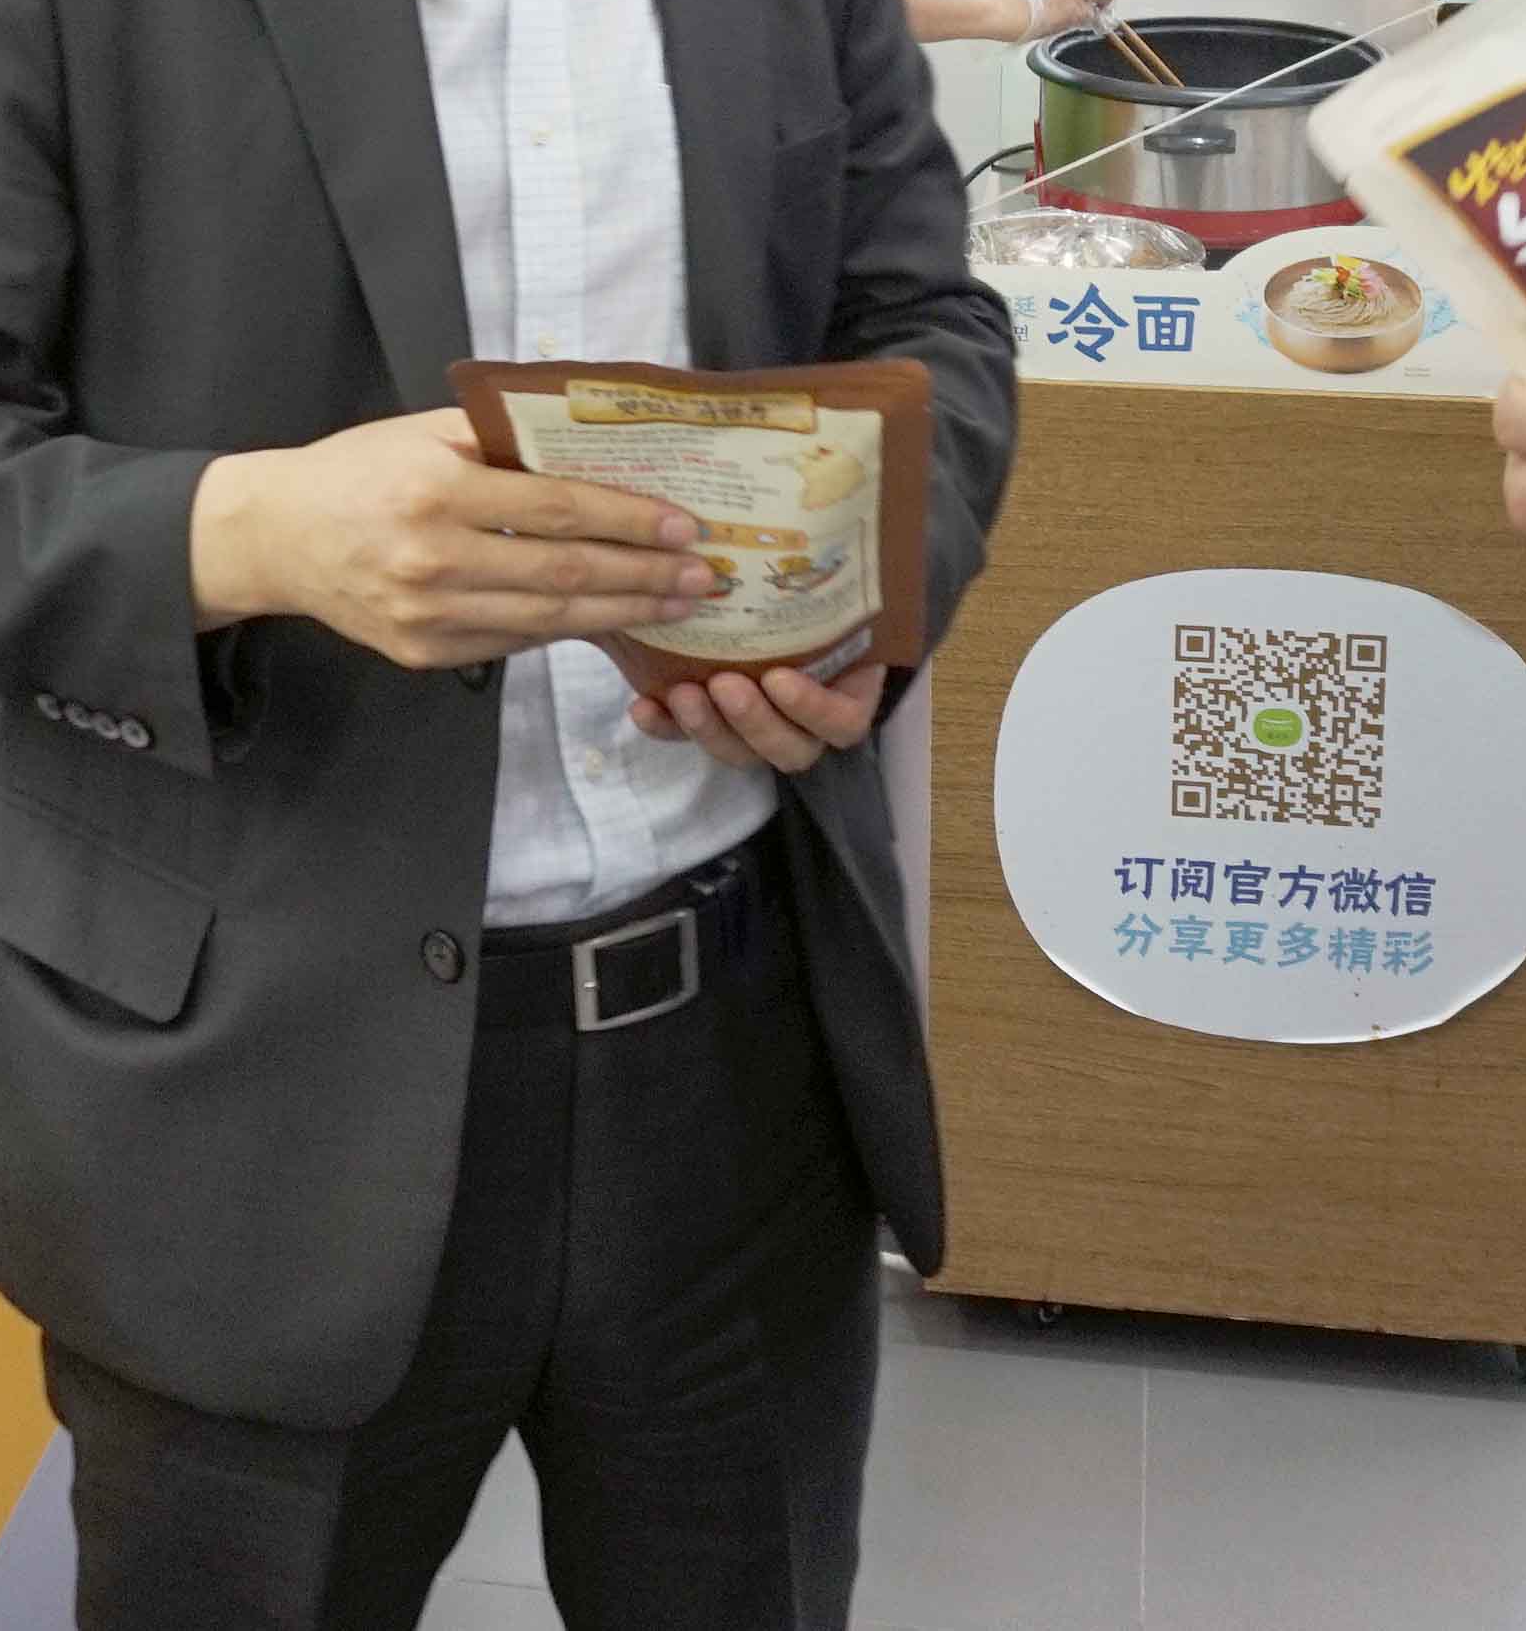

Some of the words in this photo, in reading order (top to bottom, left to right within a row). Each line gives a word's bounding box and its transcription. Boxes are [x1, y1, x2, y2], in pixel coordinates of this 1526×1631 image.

[1046, 281, 1202, 364] 冷面
[1114, 855, 1437, 919] 订阅官方微信
[1112, 913, 1435, 978] 分享更多精彩
